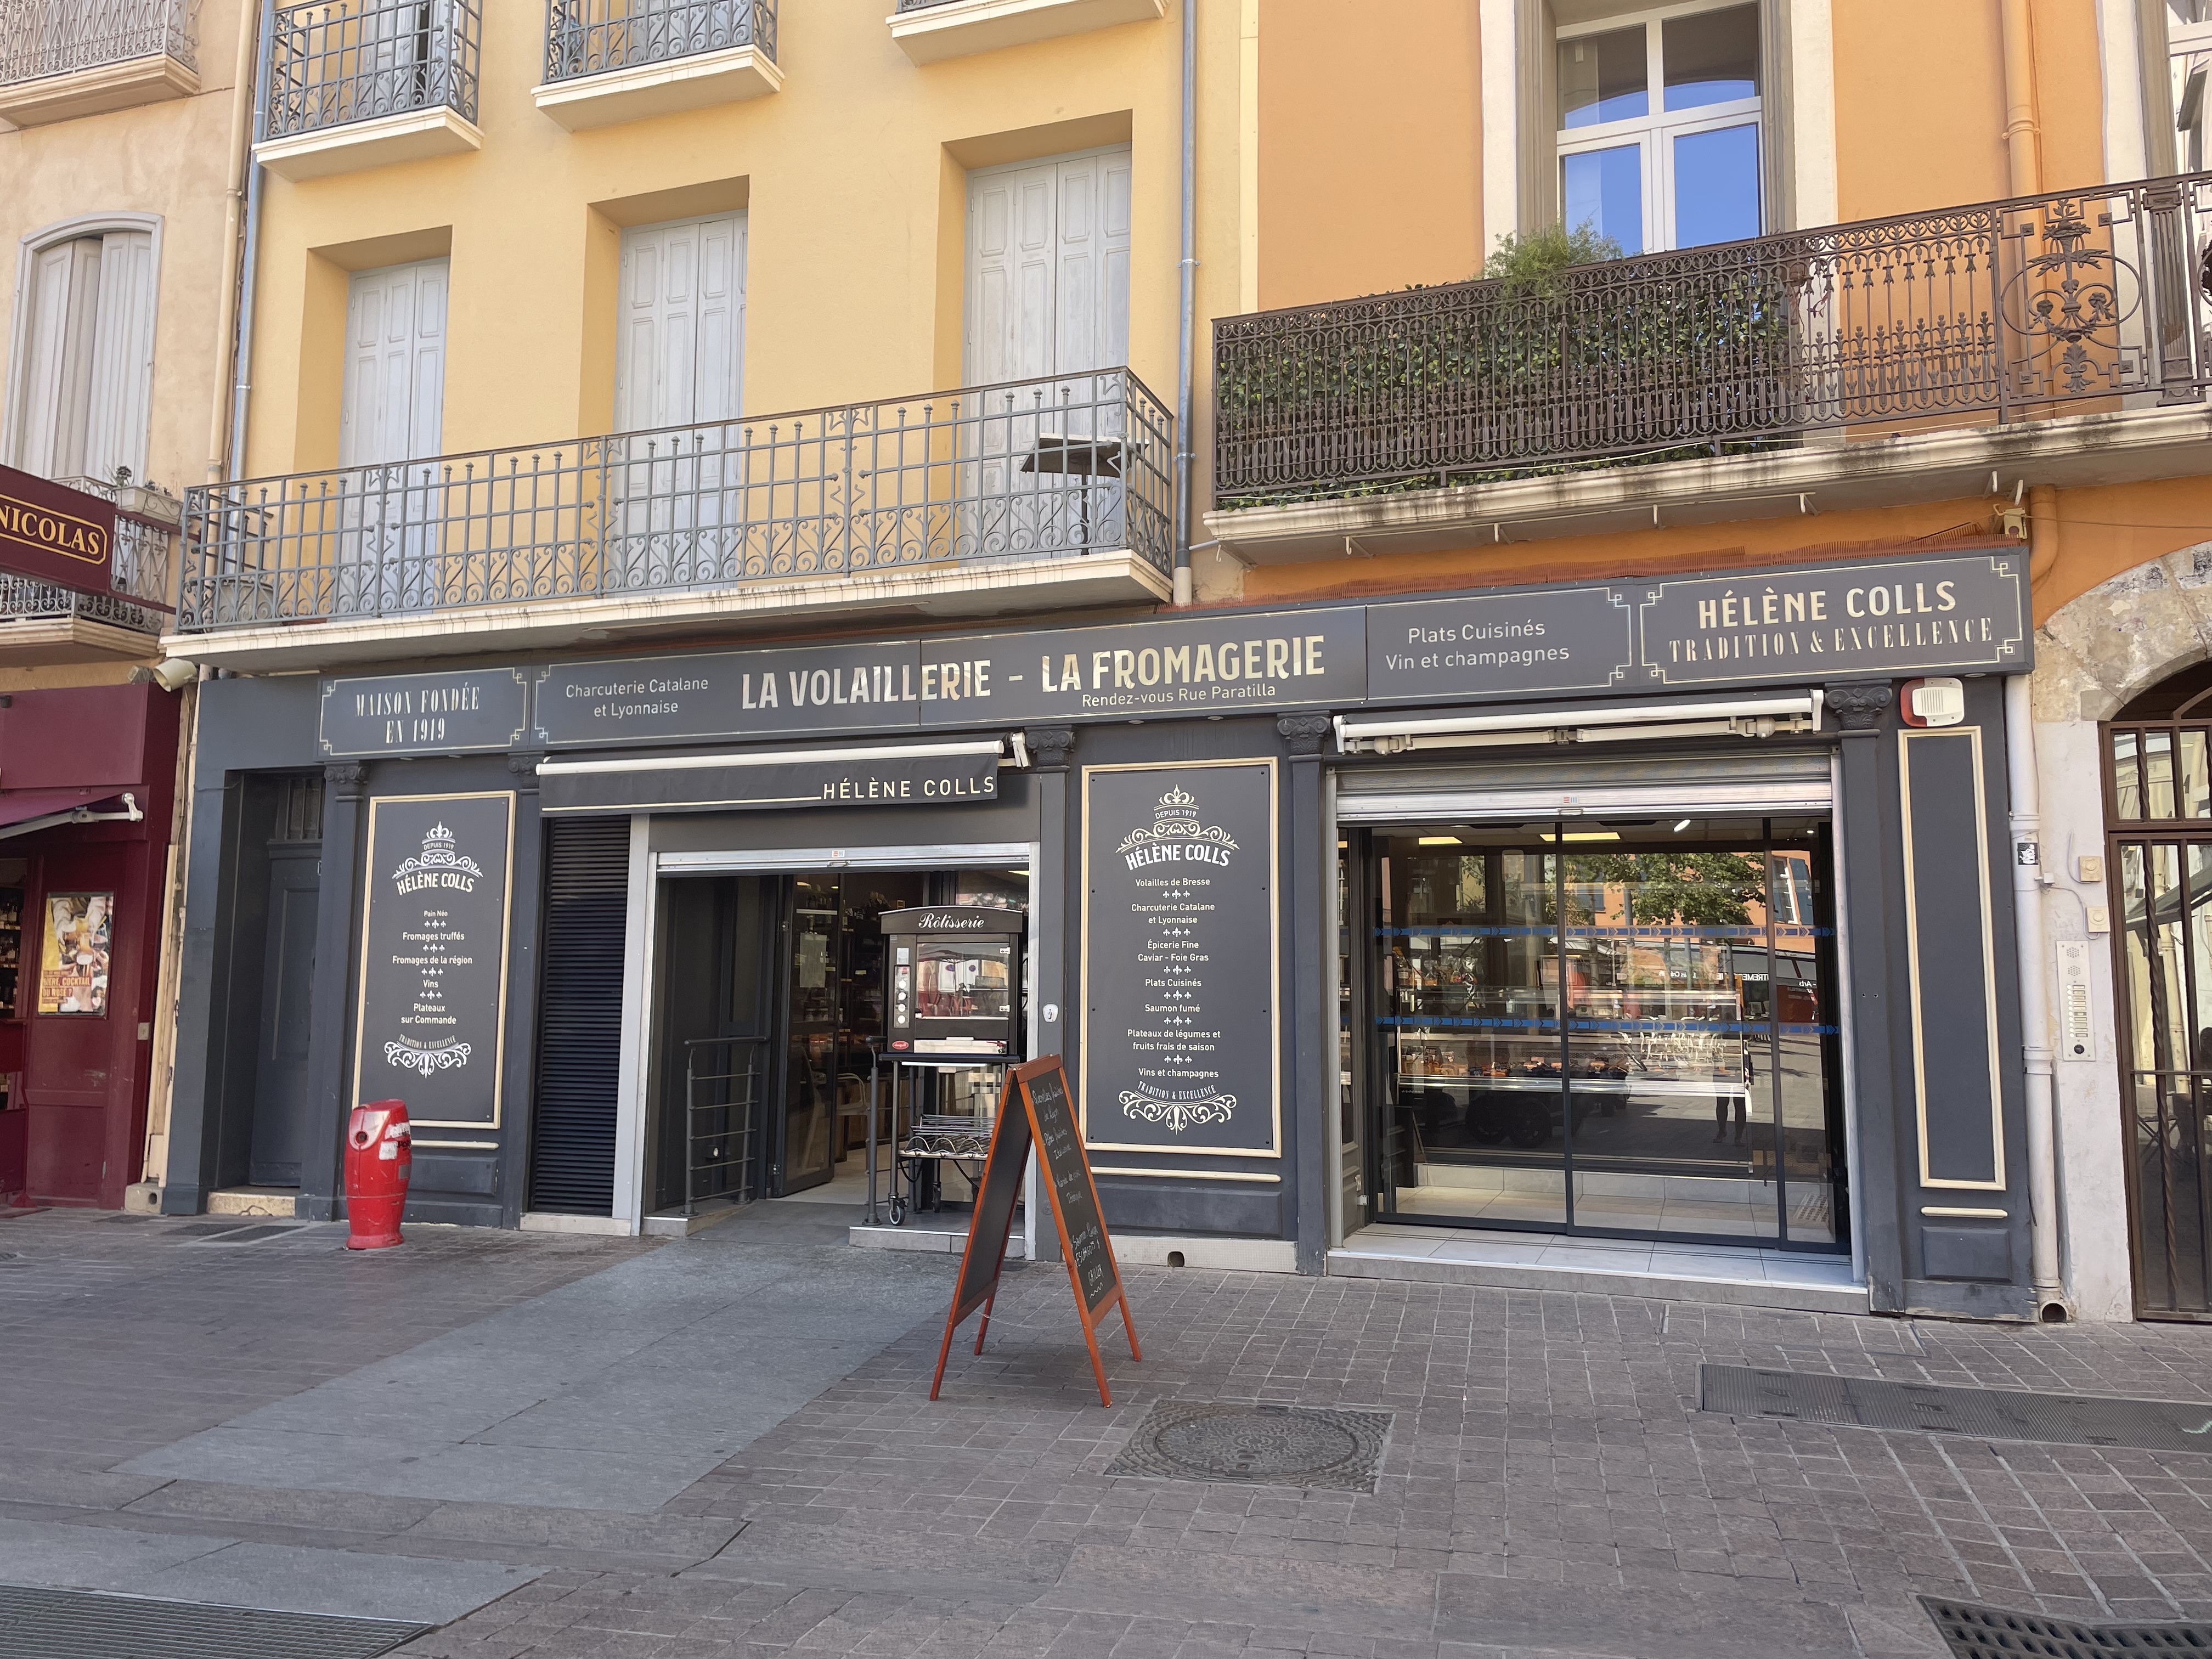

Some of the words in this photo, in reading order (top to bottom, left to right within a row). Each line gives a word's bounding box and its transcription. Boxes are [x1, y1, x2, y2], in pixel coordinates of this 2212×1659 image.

[0, 505, 99, 555] NICOLAS
[1699, 587, 1826, 629] HÉLÈNE
[1847, 581, 1955, 617] COLLS
[1409, 628, 1456, 644] Plats
[1463, 619, 1545, 640] Cuisinés
[1669, 632, 1798, 662] TRADITION
[1810, 631, 1824, 652] &
[1835, 618, 1991, 651] EXCELLENCE
[1386, 654, 1414, 670] Vin
[1421, 653, 1438, 668] et
[1446, 648, 1569, 667] champagnes
[743, 673, 778, 709] LA
[789, 660, 990, 706] VOLAILLERIE
[1042, 654, 1081, 692] LA
[1093, 635, 1325, 689] FROMAGERIE
[567, 681, 645, 697] Charcuterie
[650, 678, 708, 692] Catalane
[1083, 693, 1173, 707] Rendez-vous
[1180, 689, 1206, 701] Rue
[1212, 684, 1275, 698] Paratilla
[357, 692, 410, 716] MAISON
[421, 682, 479, 713] FONDÉE
[595, 704, 606, 716] et
[612, 700, 678, 719] Lyonnaise
[386, 720, 402, 743] EN
[414, 718, 444, 742] 1919
[824, 777, 910, 799] HÉLÈNE
[924, 776, 994, 795] COLLS
[1155, 810, 1180, 819] DEPUIS
[1125, 842, 1181, 871] HÉLÈNE
[1185, 844, 1231, 866] COLLS
[397, 871, 439, 895] HÉLÈNE
[442, 873, 474, 892] COLLS
[919, 913, 984, 928] Rôtisserie
[1159, 916, 1197, 925] Lyonnaise
[403, 932, 438, 942] Fromages
[441, 932, 464, 940] truffés
[1148, 939, 1179, 950] Épicerie
[393, 956, 428, 966] Fromages
[430, 956, 438, 964] de
[449, 955, 472, 966] région
[62, 977, 90, 986] COCKTAIL
[423, 979, 438, 988] Vins
[1168, 978, 1201, 986] Cuisinés
[42, 988, 50, 997] OU
[414, 1003, 445, 1012] Plateaux
[415, 1015, 456, 1024] Commande
[399, 1034, 422, 1048] TRADITION
[428, 1035, 456, 1049] EXCELLENCE
[1176, 1030, 1210, 1039] légumes
[1167, 1069, 1218, 1079] champagnes
[1138, 1081, 1169, 1099] TRADITION
[1172, 1091, 1176, 1099] &
[1178, 1085, 1216, 1101] EXCELLENCE
